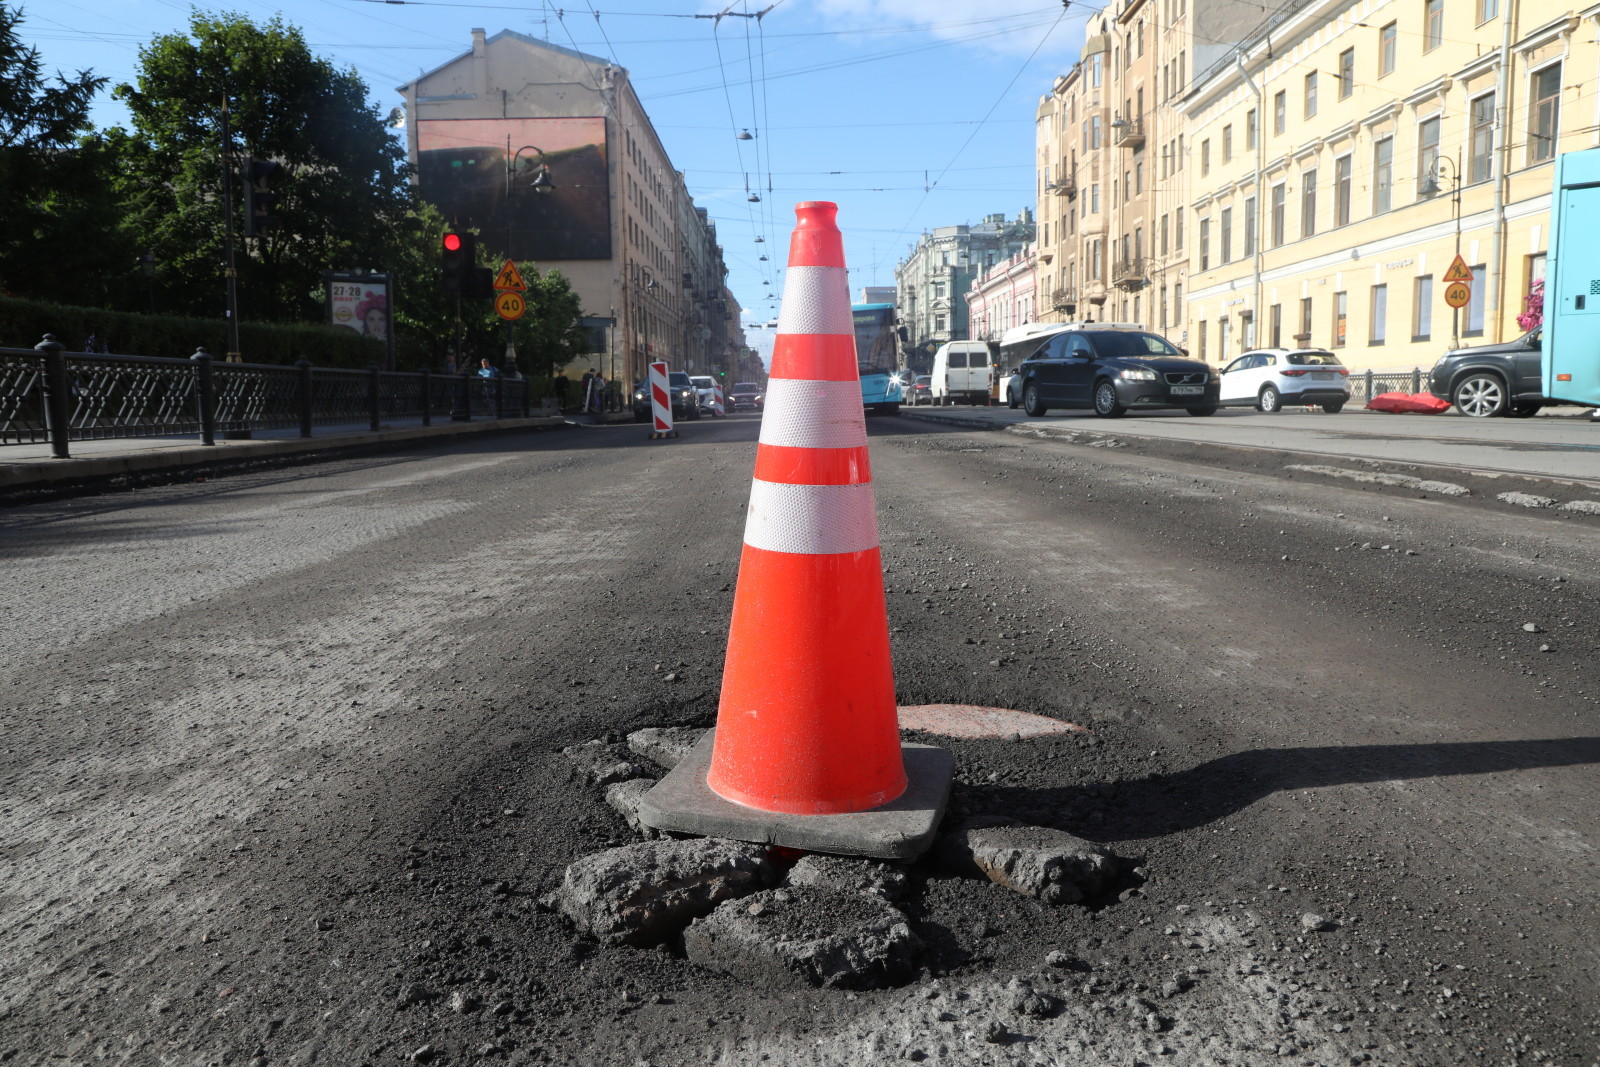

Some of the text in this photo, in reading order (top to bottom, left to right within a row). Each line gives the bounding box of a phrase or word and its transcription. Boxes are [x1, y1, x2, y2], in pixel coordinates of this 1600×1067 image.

[333, 286, 361, 296] 27-28
[1450, 289, 1466, 300] 40
[501, 299, 519, 312] 40
